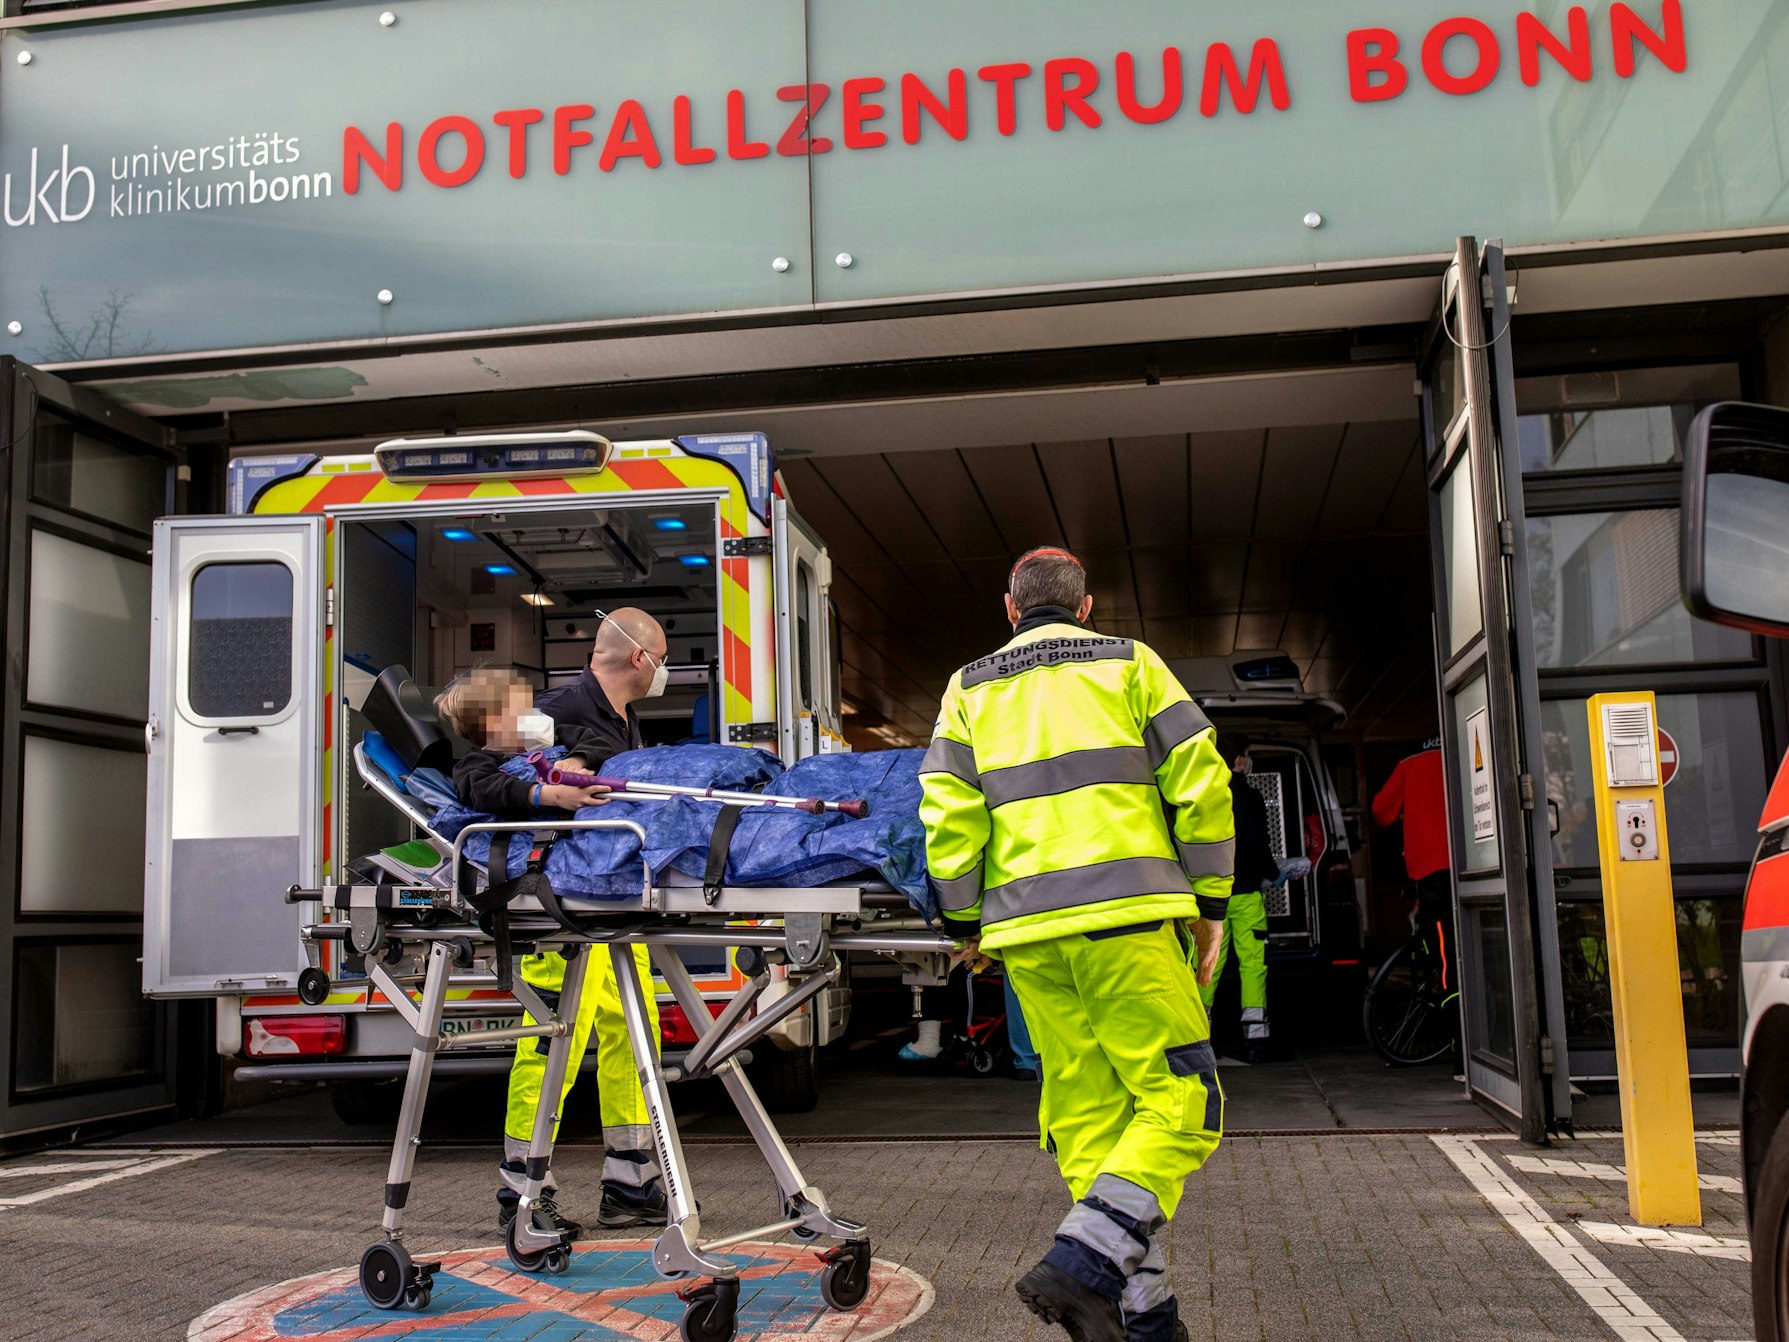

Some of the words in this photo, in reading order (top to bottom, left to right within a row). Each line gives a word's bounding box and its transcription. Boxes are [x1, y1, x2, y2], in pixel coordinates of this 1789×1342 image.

[343, 38, 1291, 195] NOTFALLZENTRUM
[1346, 0, 1688, 103] BONN
[111, 132, 300, 181] universitäts
[4, 144, 95, 227] ukb
[110, 170, 332, 218] klinikumbonn
[965, 638, 1128, 674] RETTUNGSDIENST
[997, 653, 1043, 675] Stadt
[1048, 650, 1094, 664] Bonn
[651, 1104, 679, 1198] STOLLENWERK
